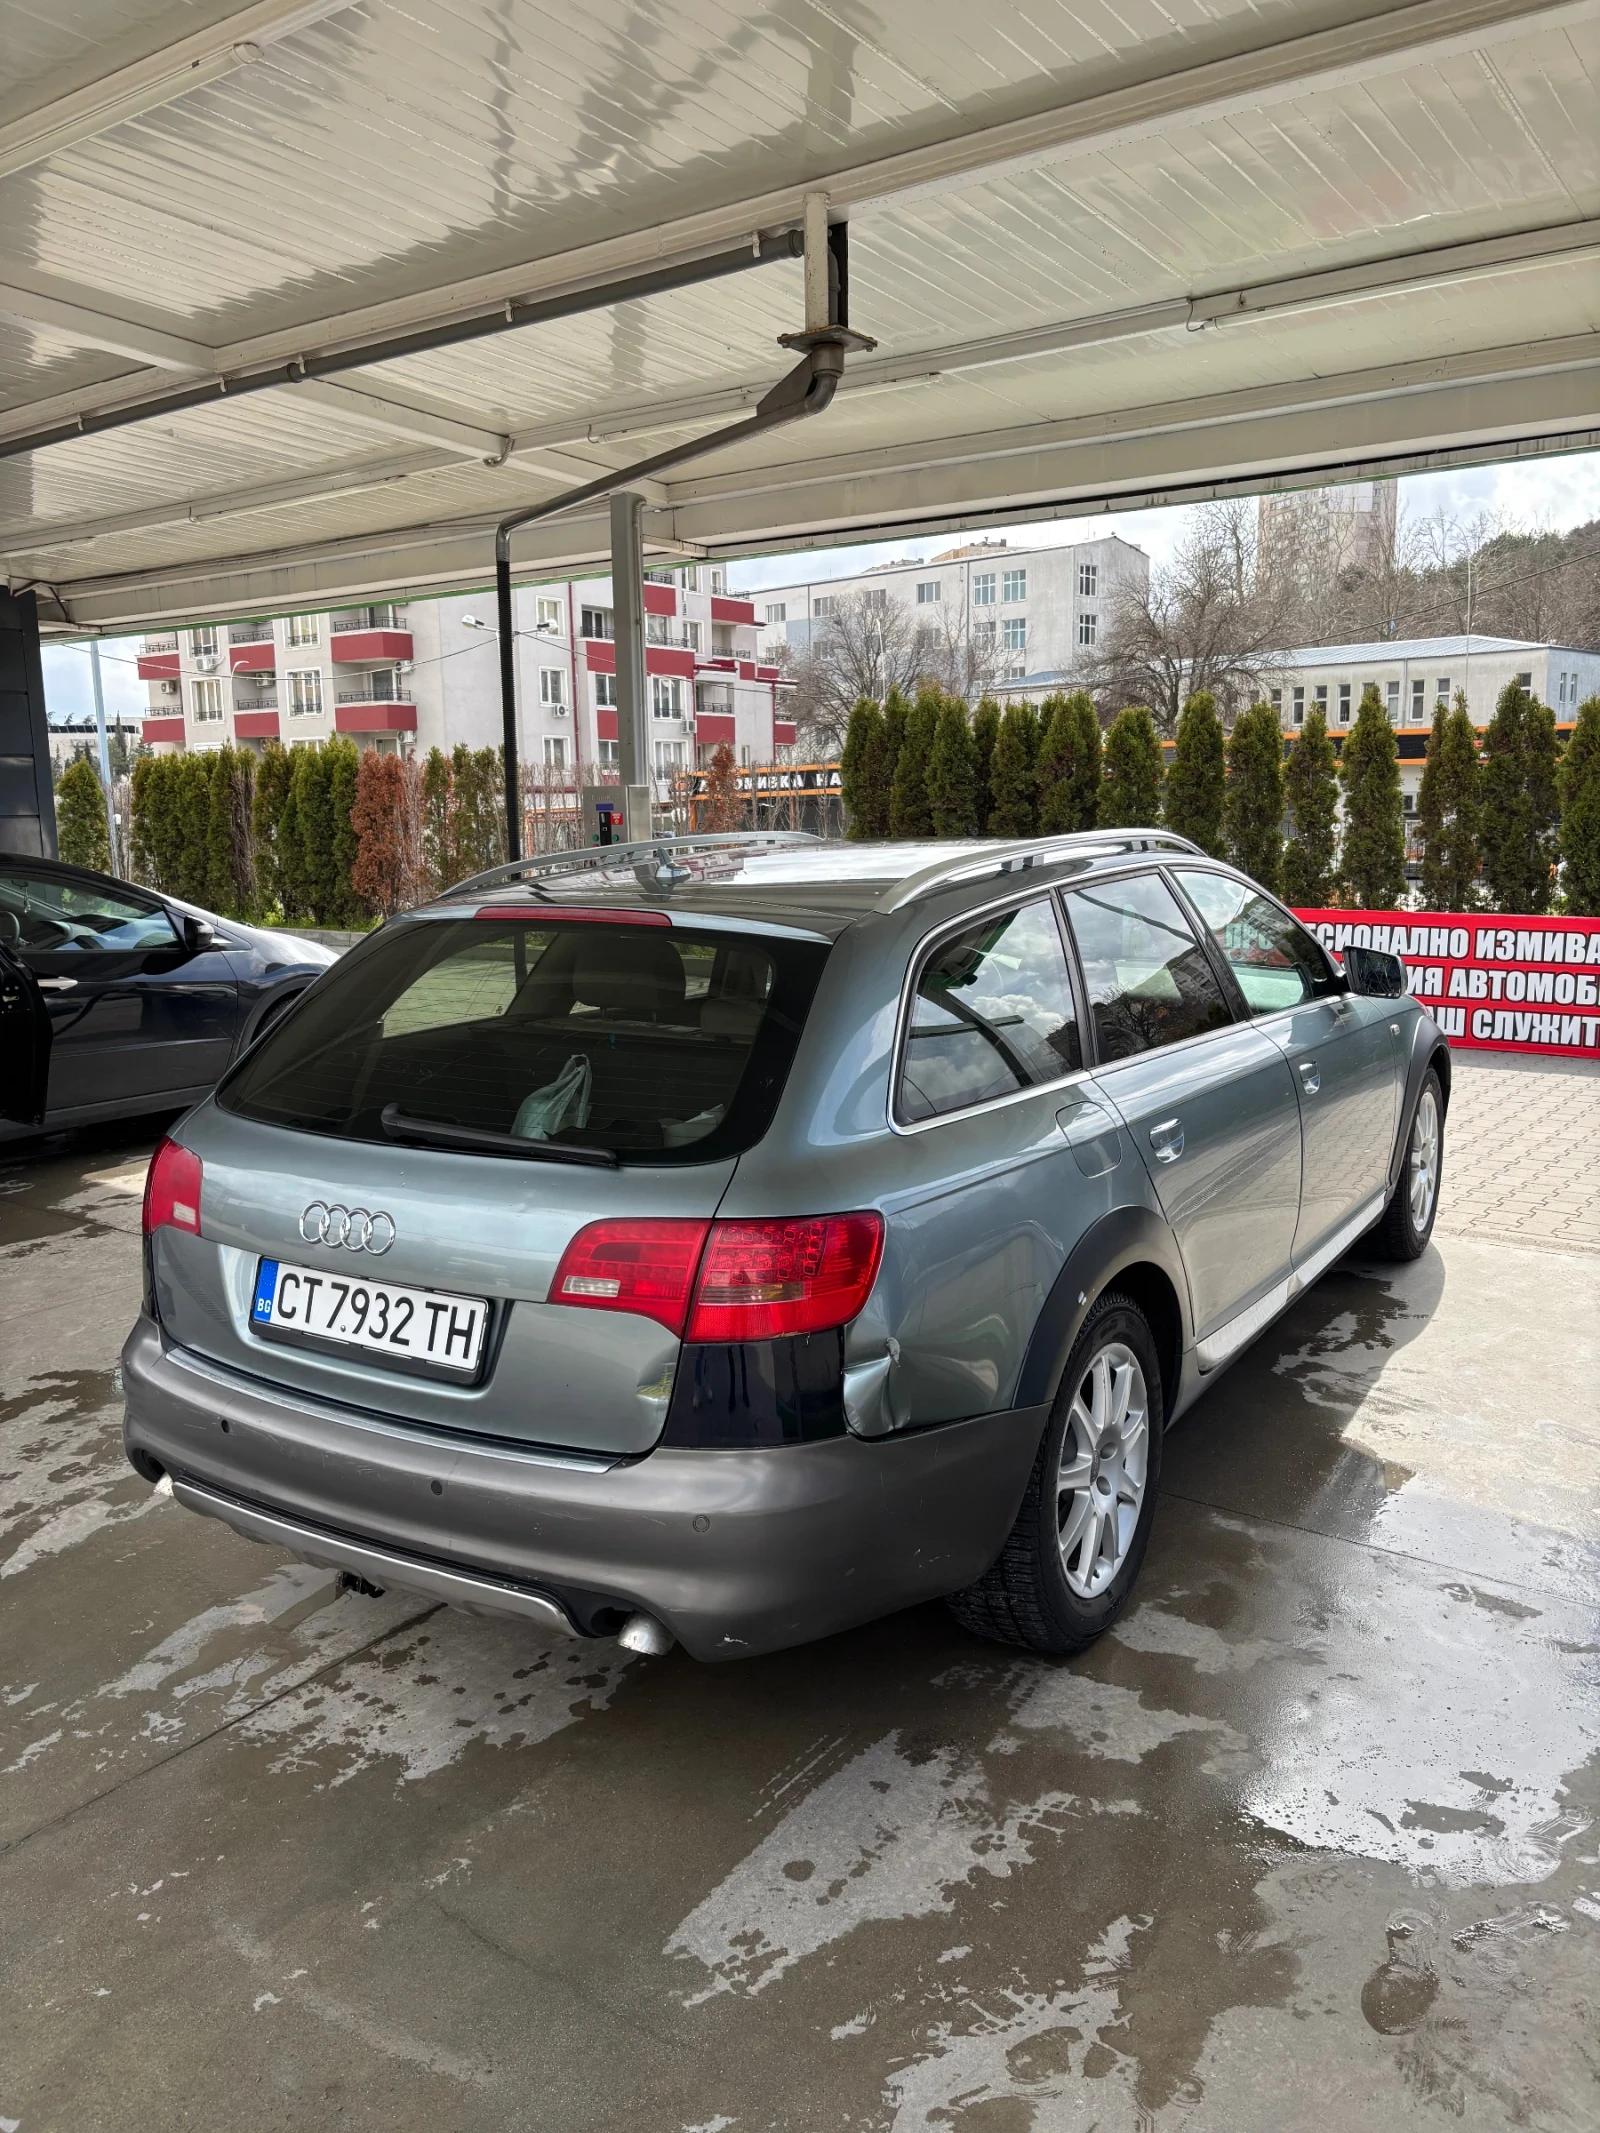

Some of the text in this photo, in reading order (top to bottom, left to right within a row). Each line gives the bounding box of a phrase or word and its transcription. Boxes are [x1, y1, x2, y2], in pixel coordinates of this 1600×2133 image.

[1448, 967, 1600, 1006] АВТОМОБ
[256, 1297, 272, 1315] BG
[277, 1272, 476, 1360] CT 7932 TH
